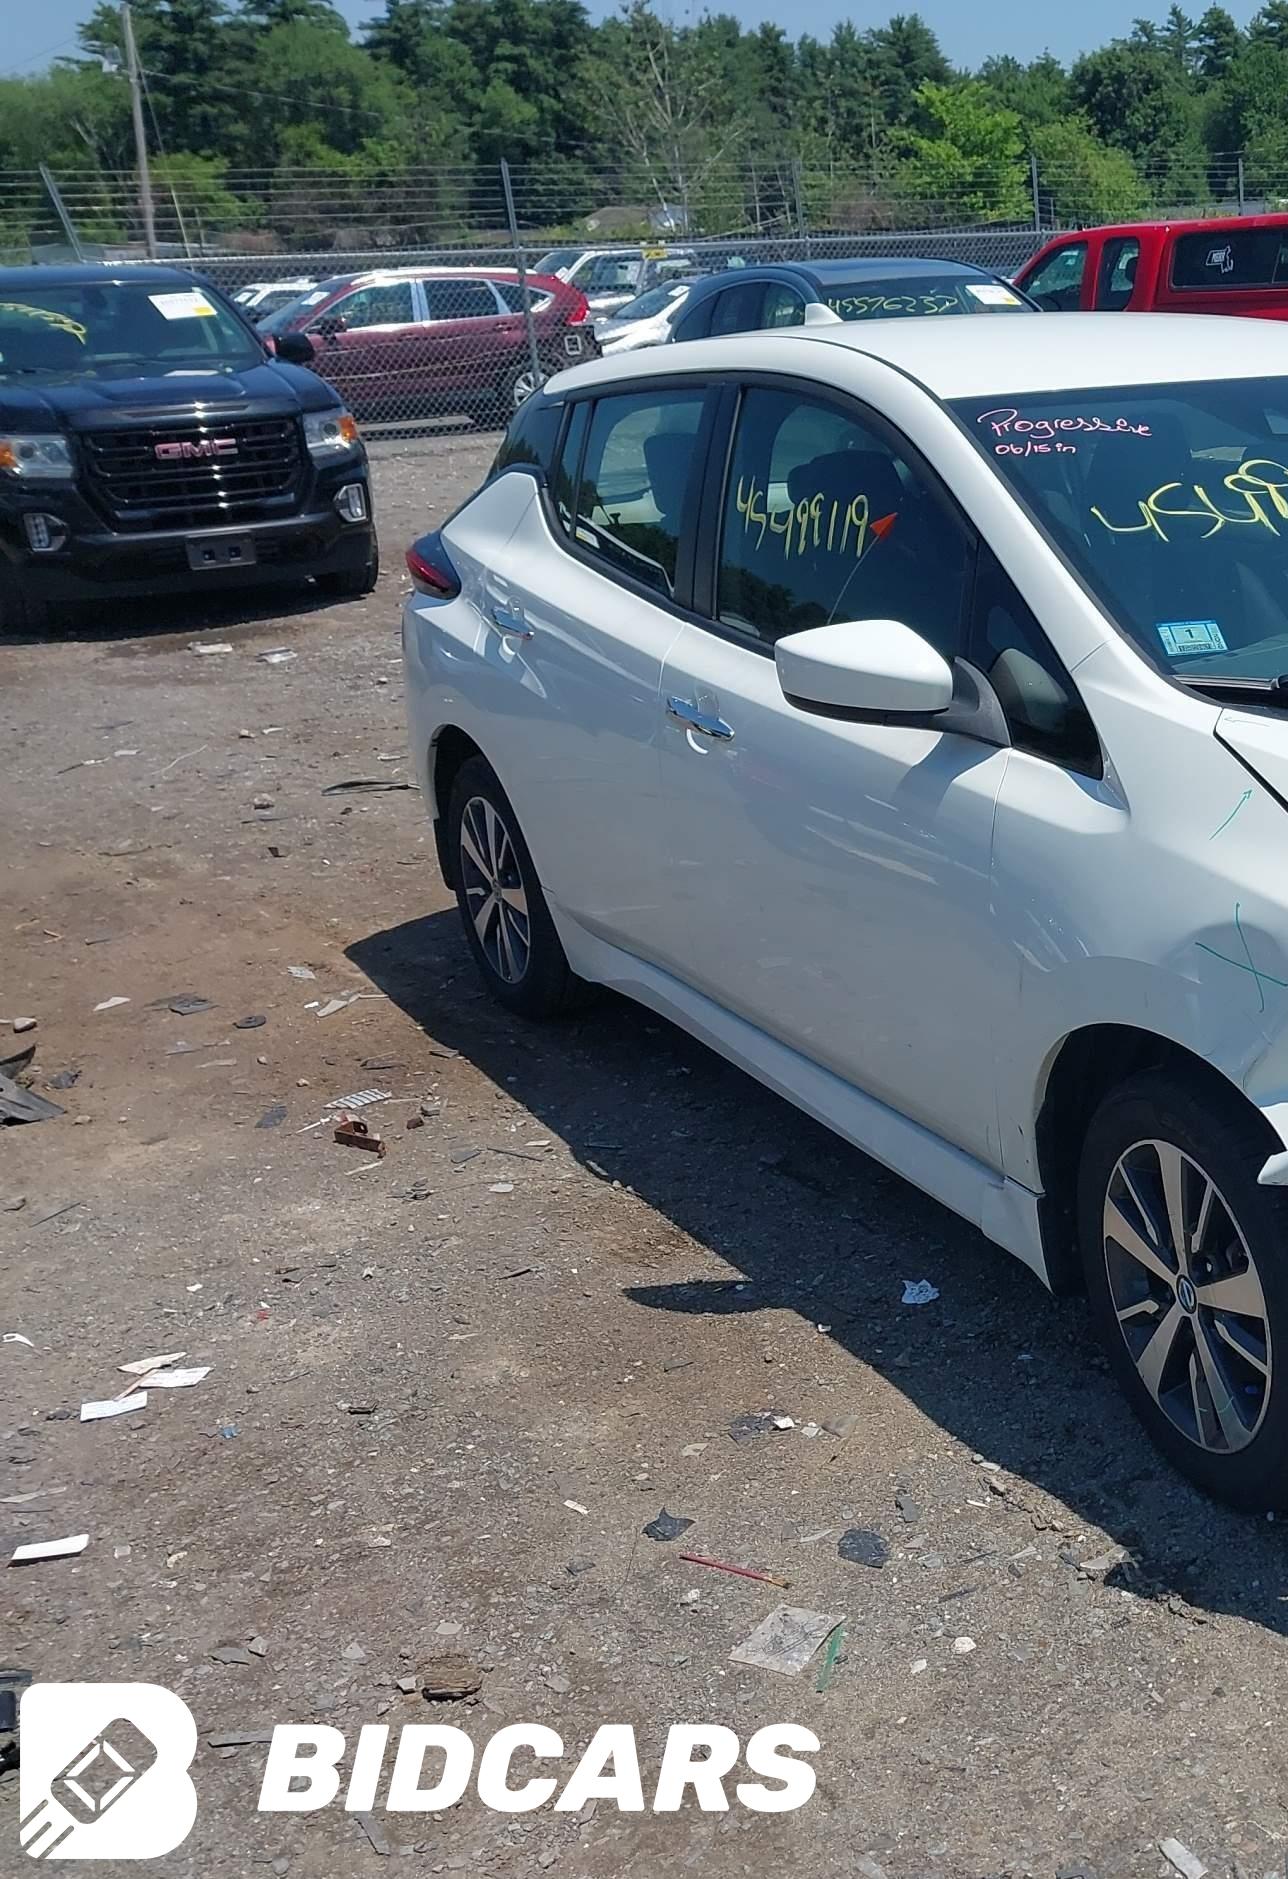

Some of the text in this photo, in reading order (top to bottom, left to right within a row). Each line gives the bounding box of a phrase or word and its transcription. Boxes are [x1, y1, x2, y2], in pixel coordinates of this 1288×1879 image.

[977, 408, 1153, 439] Progressive
[154, 437, 239, 460] GMC
[995, 441, 1076, 457] 06/15 in
[1184, 628, 1194, 639] 1
